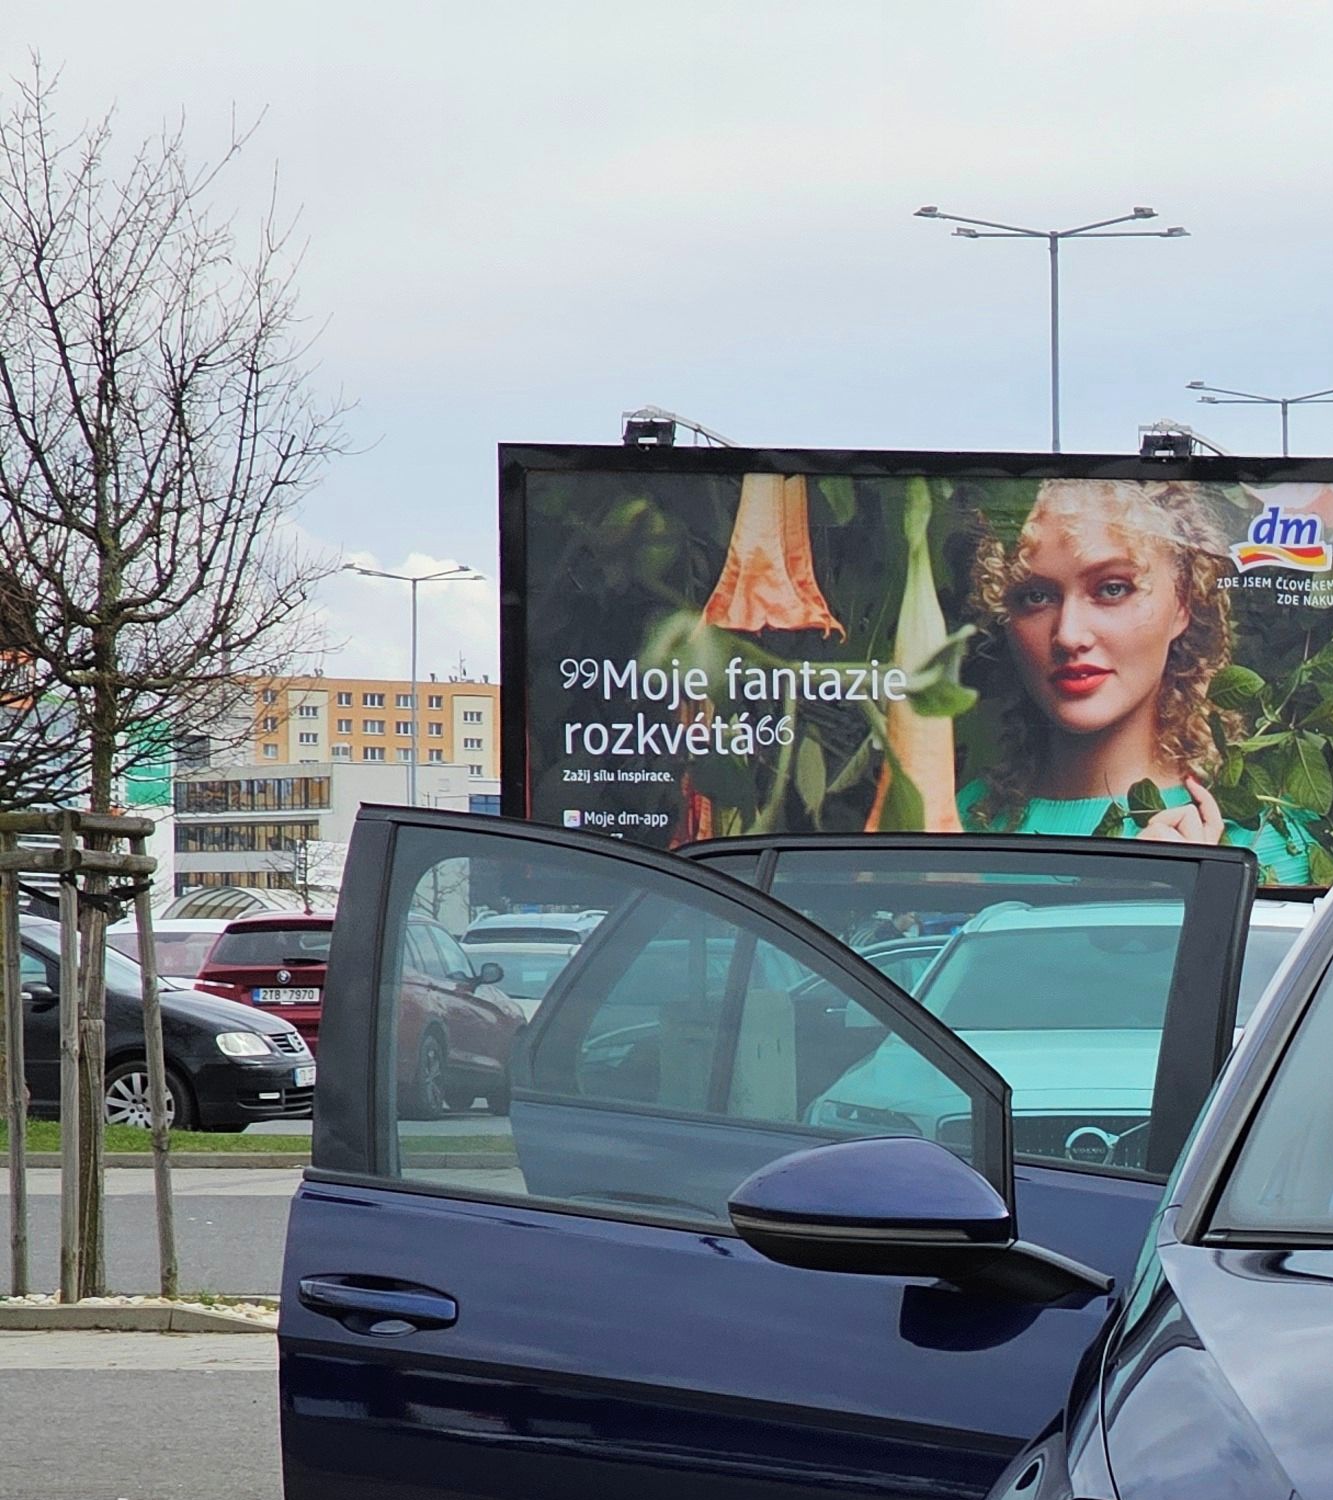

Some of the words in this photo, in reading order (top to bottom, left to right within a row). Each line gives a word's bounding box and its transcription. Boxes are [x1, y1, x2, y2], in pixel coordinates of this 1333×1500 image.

[1253, 507, 1317, 544] dm
[1216, 577, 1239, 589] ZDE
[1242, 576, 1272, 588] JSEM
[1277, 593, 1299, 605] ZDE
[724, 656, 907, 700] fantazie
[563, 770, 591, 784] Zažij
[593, 770, 615, 782] sílu
[618, 769, 675, 784] inspirace.
[584, 811, 615, 828] Moje
[618, 811, 669, 828] dm-app
[262, 990, 281, 1000] 2TB
[288, 990, 314, 1000] 7970
